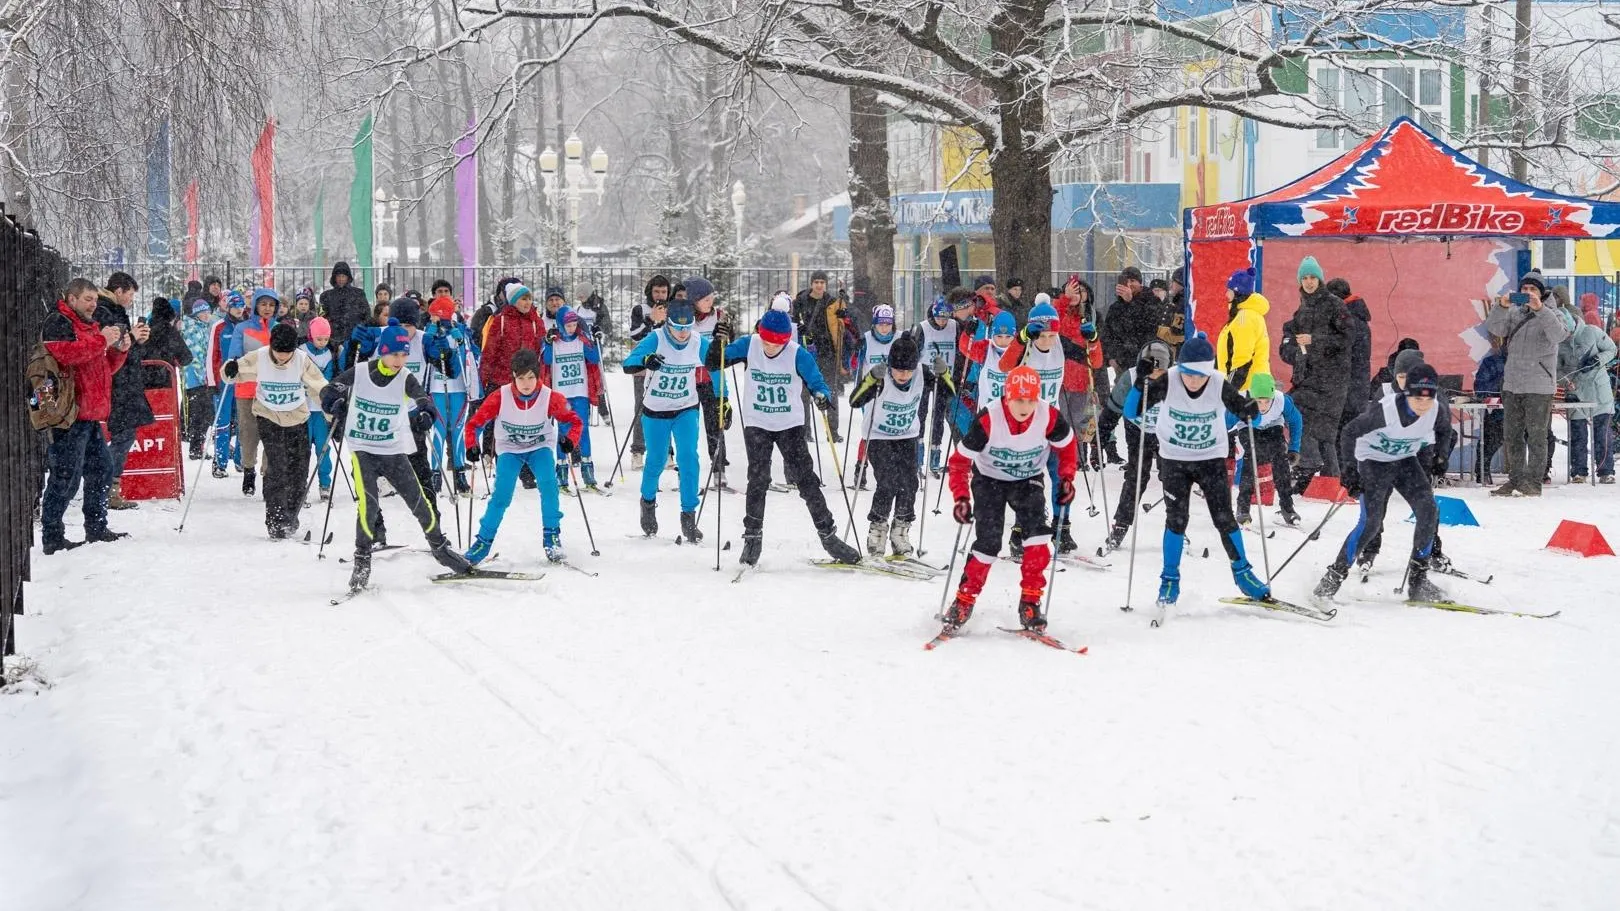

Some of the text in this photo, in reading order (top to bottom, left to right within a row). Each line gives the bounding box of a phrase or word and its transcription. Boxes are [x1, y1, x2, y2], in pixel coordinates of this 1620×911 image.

[1376, 203, 1525, 234] redBike
[930, 351, 950, 364] 31
[1012, 373, 1037, 388] DNB
[757, 385, 787, 404] 318
[1041, 382, 1057, 400] 14
[1174, 424, 1212, 441] 323
[129, 437, 166, 453] АРТ
